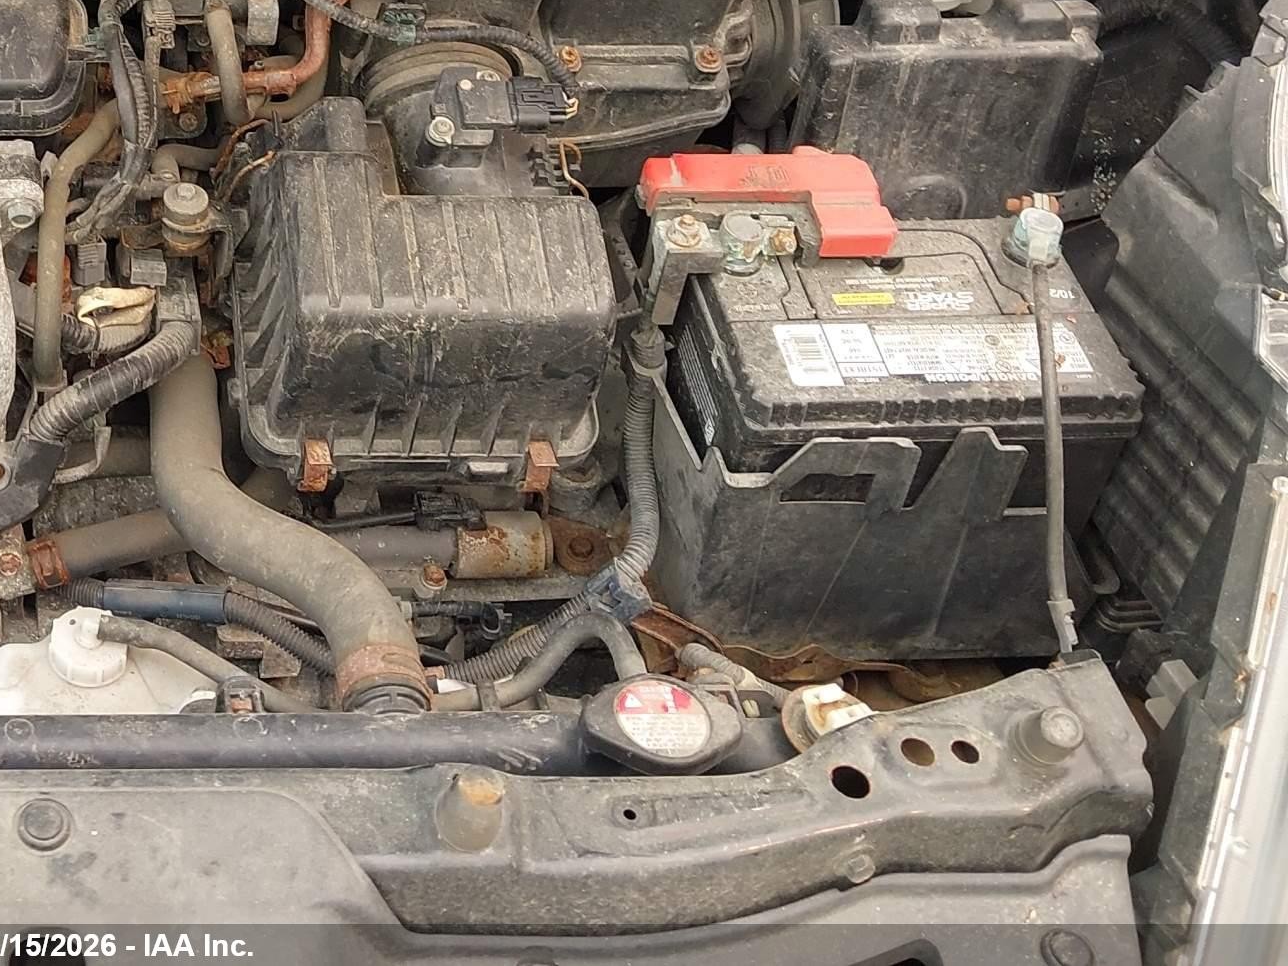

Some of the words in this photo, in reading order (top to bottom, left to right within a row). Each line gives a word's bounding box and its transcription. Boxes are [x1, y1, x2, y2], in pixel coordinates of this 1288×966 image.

[904, 291, 974, 304] START
[1048, 288, 1076, 300] 10/2
[905, 301, 970, 311] SUPER
